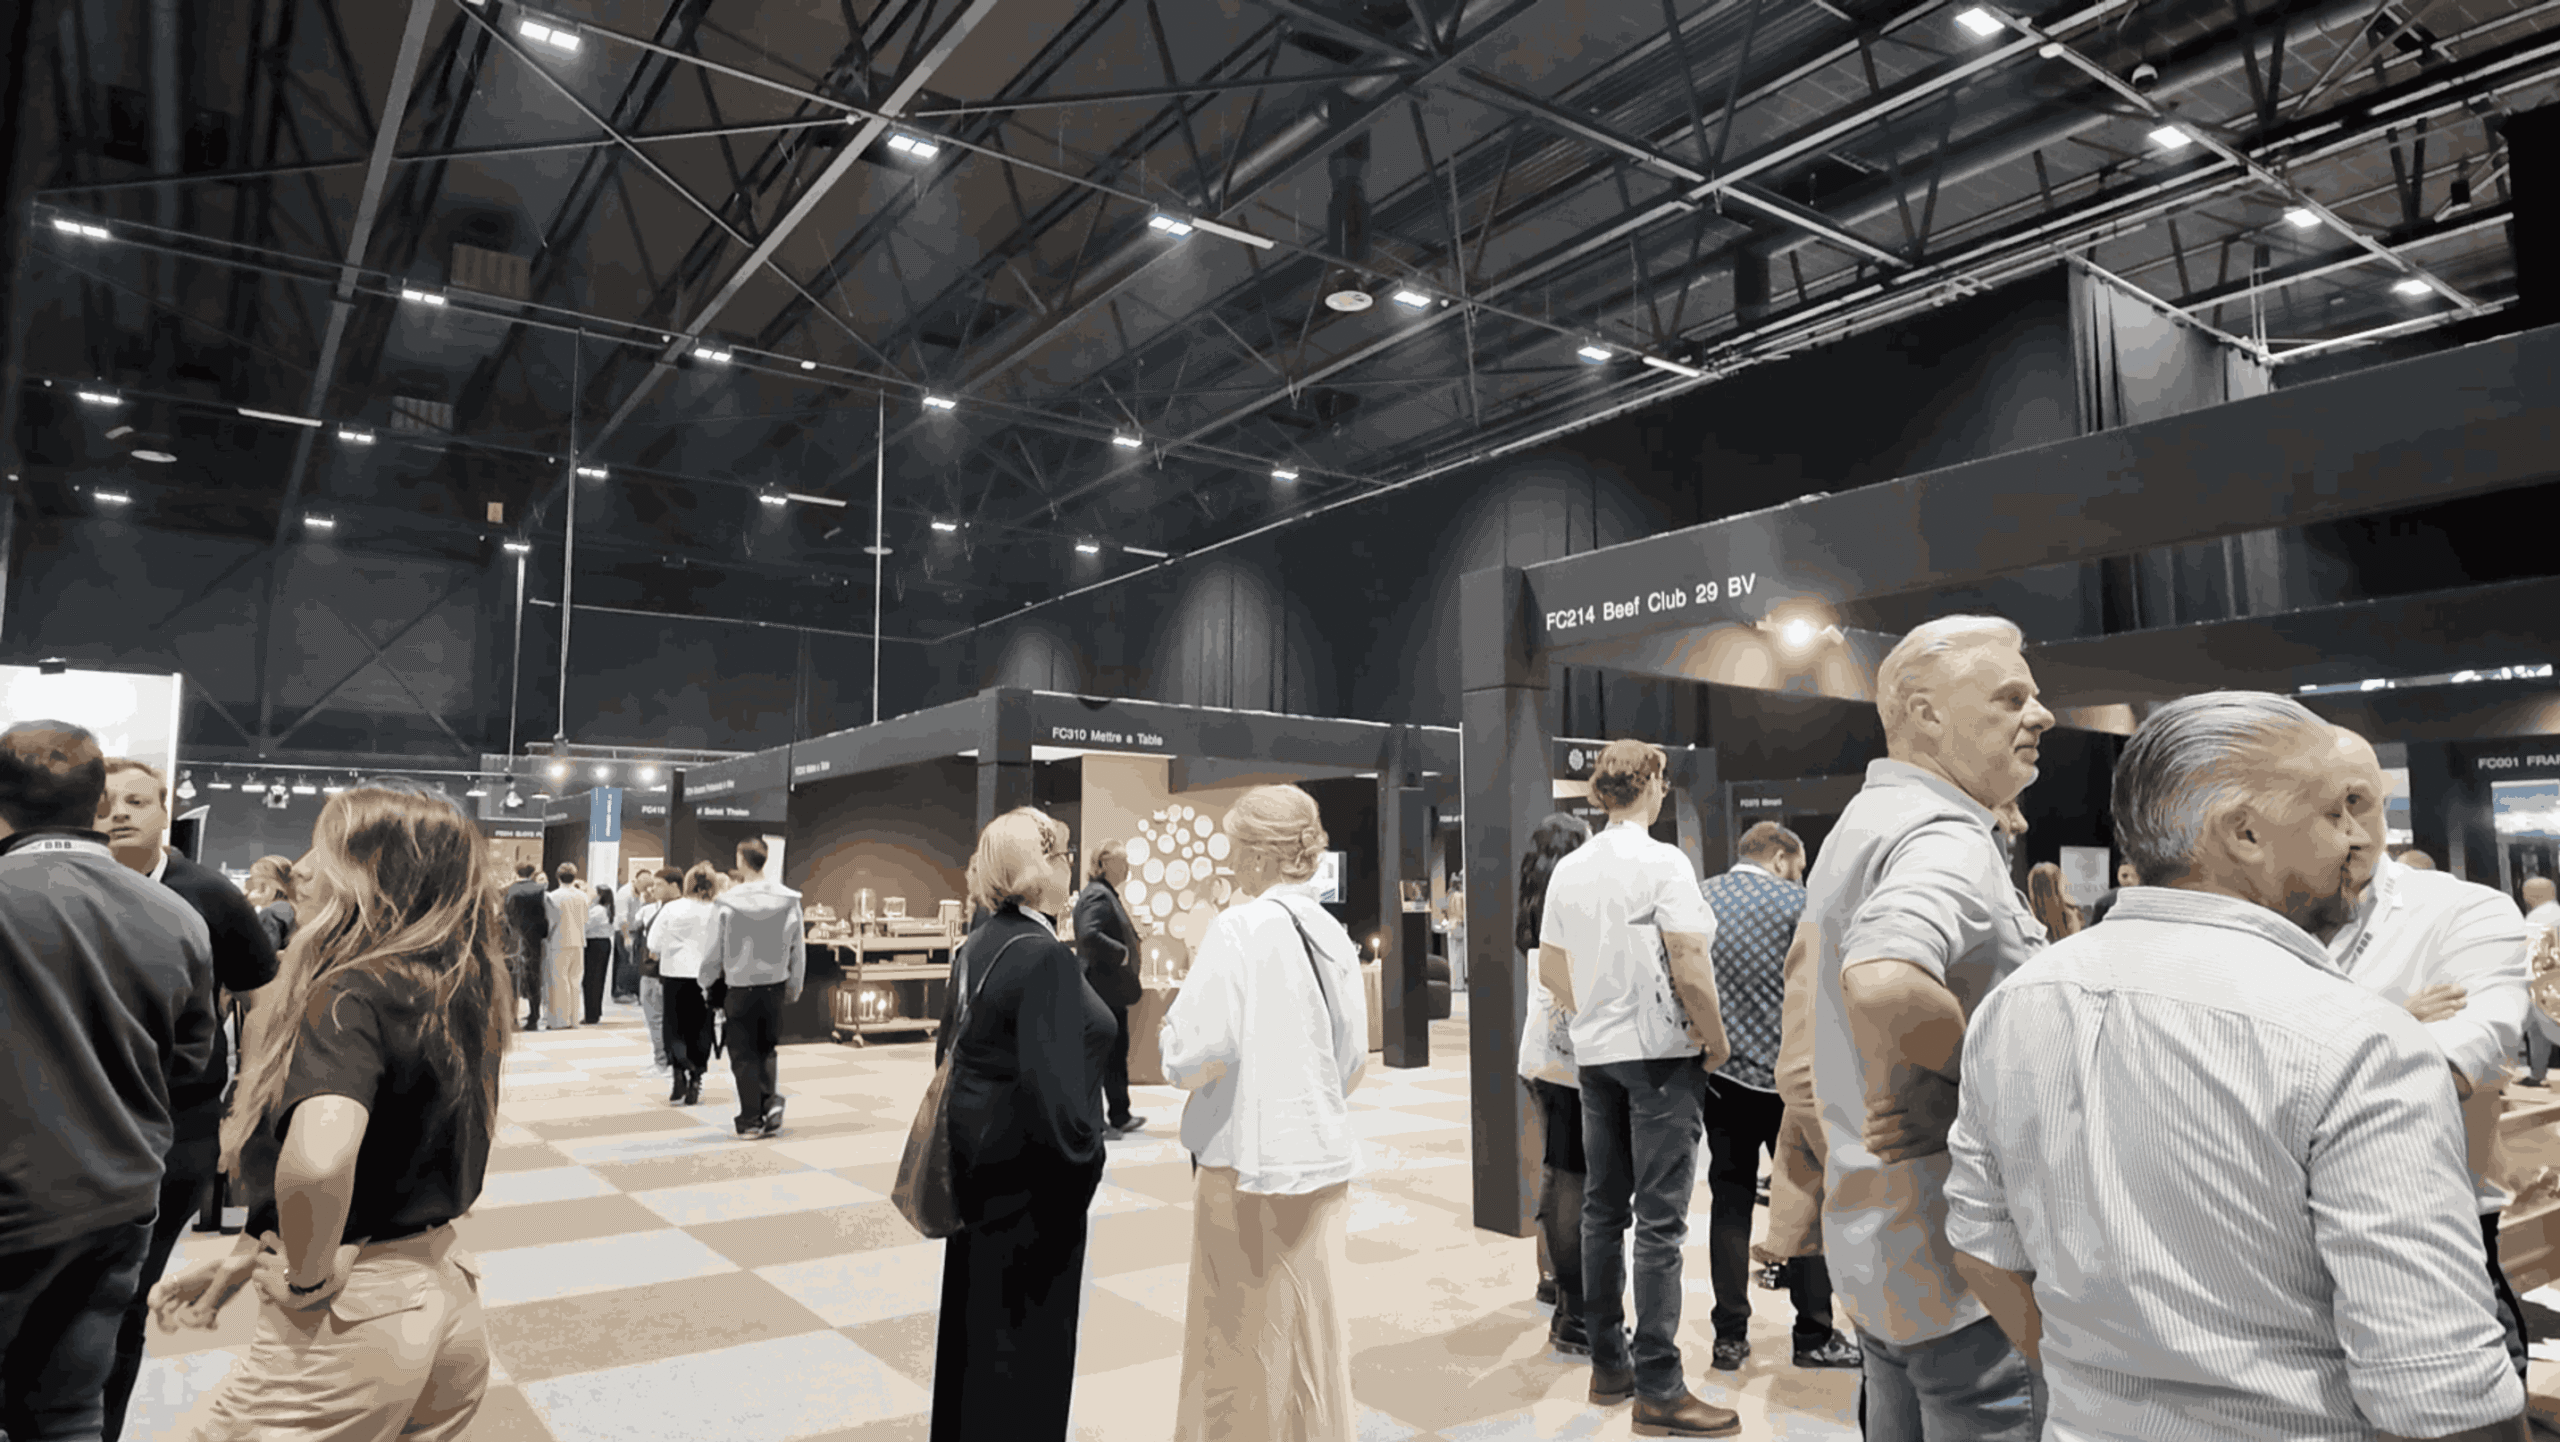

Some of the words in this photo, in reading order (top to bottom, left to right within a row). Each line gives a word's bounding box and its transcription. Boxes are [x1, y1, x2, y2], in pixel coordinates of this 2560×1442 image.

[1546, 605, 1595, 631] FC214
[1603, 596, 1640, 621] Beef
[1648, 589, 1687, 613] Club
[1695, 582, 1719, 604] 29
[1728, 573, 1756, 598] BV
[1052, 726, 1087, 741] FC310
[1137, 733, 1163, 746] Table
[2478, 756, 2519, 769] FC001
